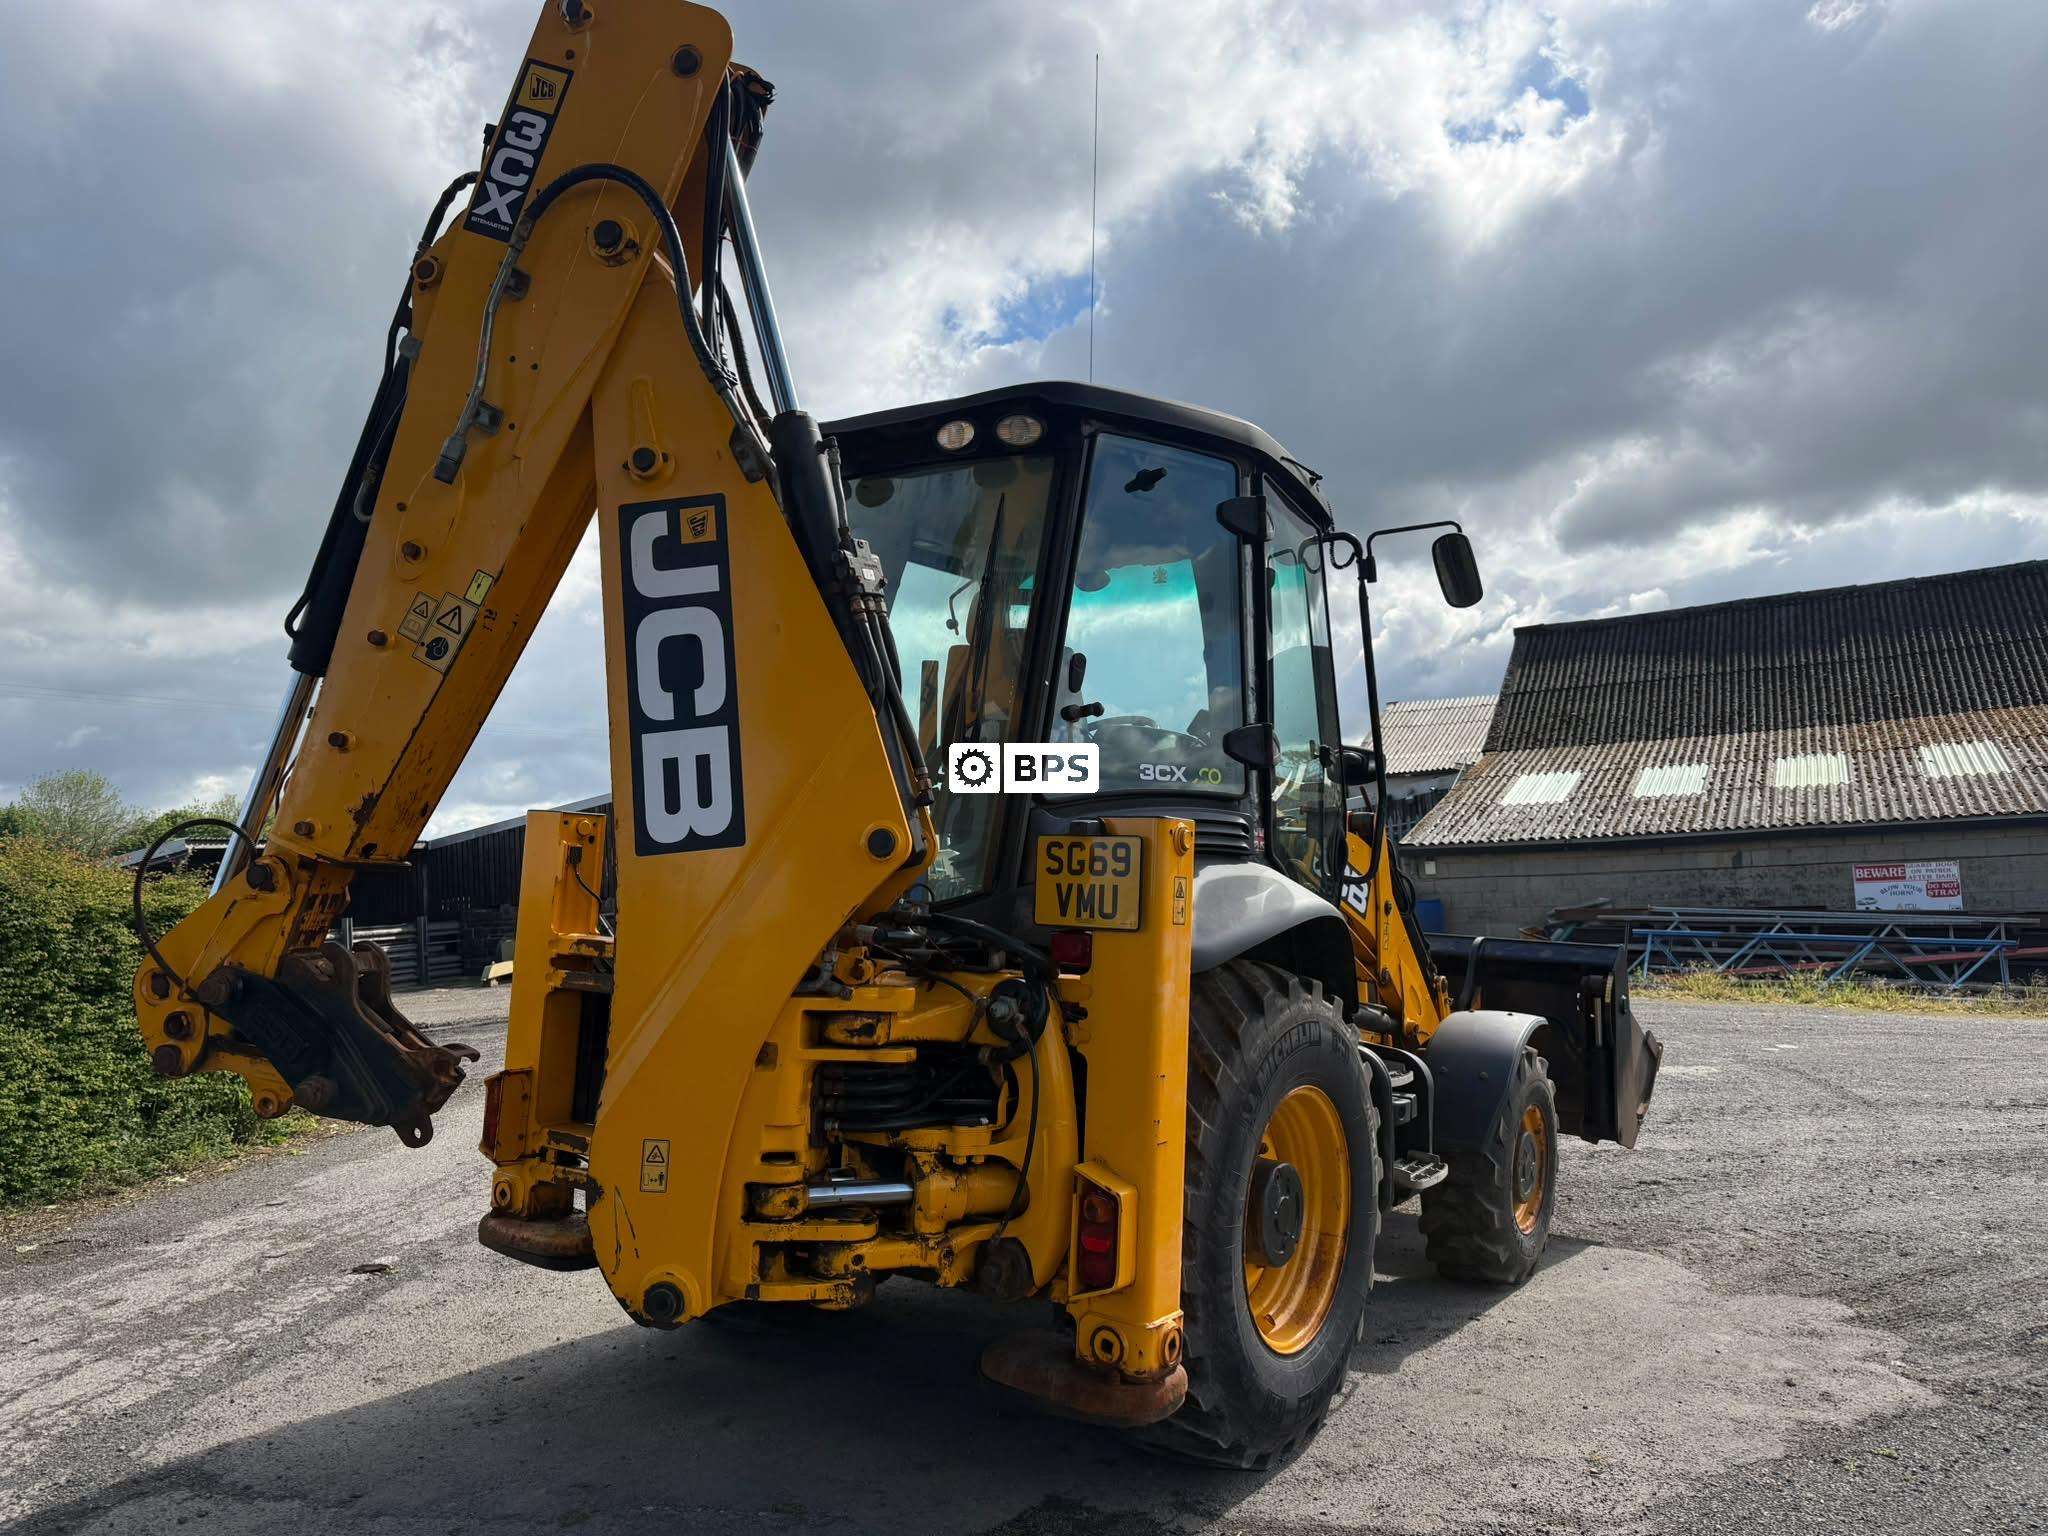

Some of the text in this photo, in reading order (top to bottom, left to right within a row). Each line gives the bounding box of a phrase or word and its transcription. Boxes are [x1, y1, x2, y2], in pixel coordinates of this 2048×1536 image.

[532, 77, 555, 98] JCB
[472, 111, 547, 224] 3CX
[630, 510, 732, 843] JCB
[1139, 763, 1187, 782] 3CX
[1045, 841, 1131, 878] SG69
[1855, 867, 1905, 879] BEWARE
[1055, 882, 1119, 920] VMU
[1927, 889, 1960, 897] STRAY
